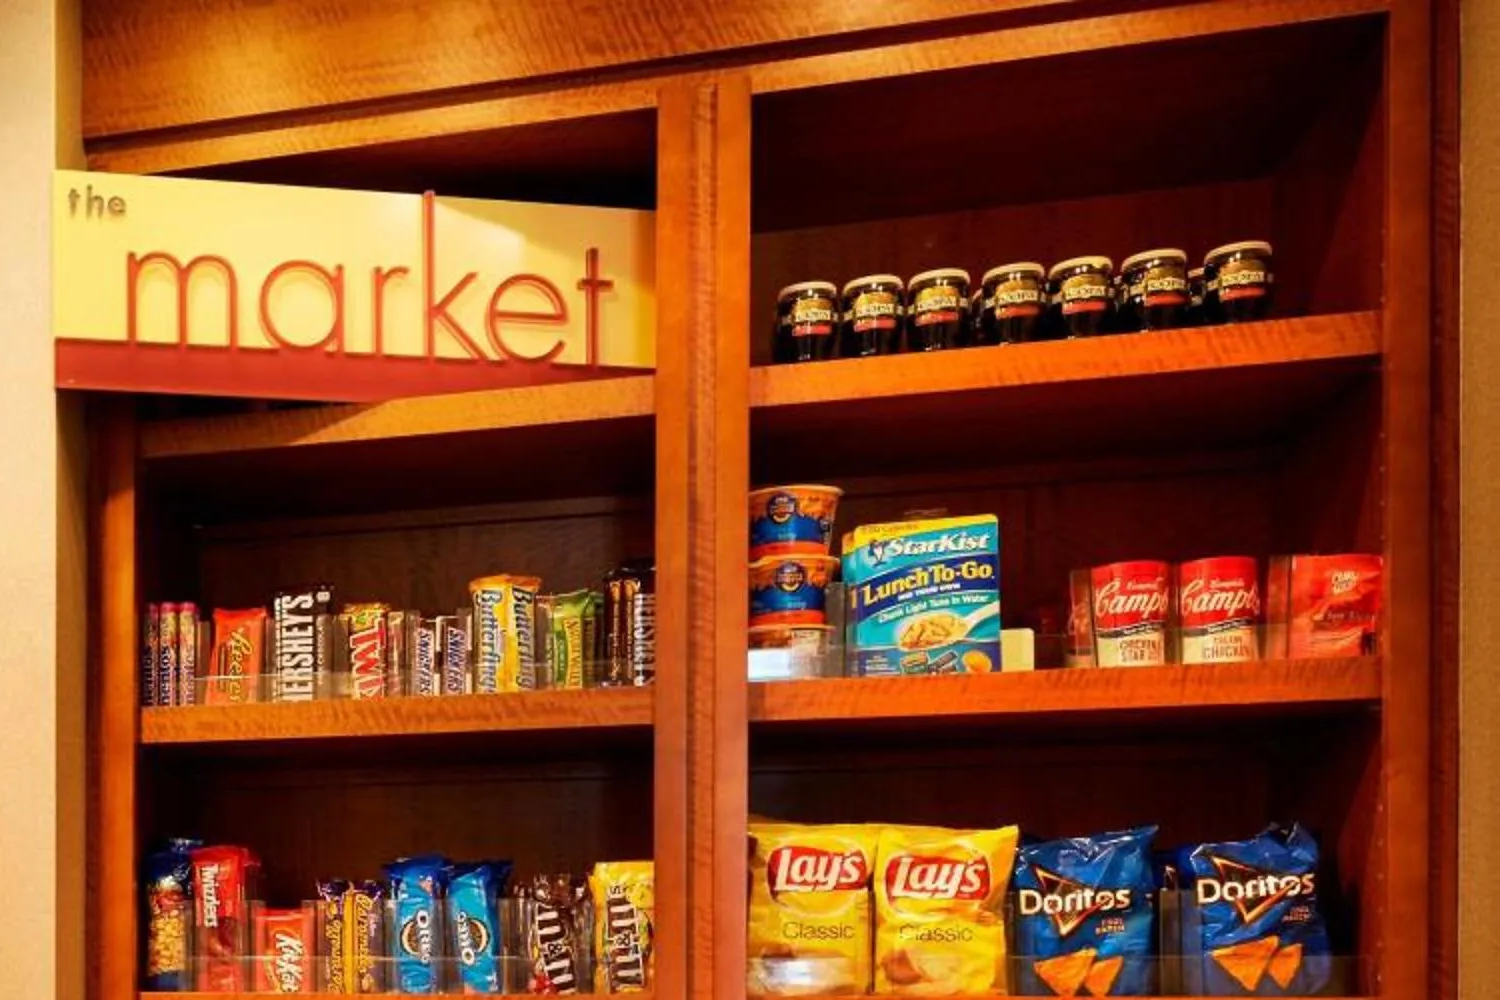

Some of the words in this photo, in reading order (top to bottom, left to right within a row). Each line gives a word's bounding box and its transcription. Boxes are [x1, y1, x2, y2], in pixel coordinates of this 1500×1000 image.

[68, 184, 127, 219] the
[126, 190, 614, 366] market
[891, 531, 991, 555] StarKist
[863, 568, 930, 607] Lunch
[933, 561, 994, 584] To-Go
[479, 587, 504, 695] Butterfing
[511, 587, 538, 691] Butterfing
[773, 847, 865, 893] Lay's
[889, 855, 988, 900] Lay's
[1196, 872, 1316, 905] Doritos
[1019, 888, 1132, 916] Doritos
[782, 921, 856, 940] Classic
